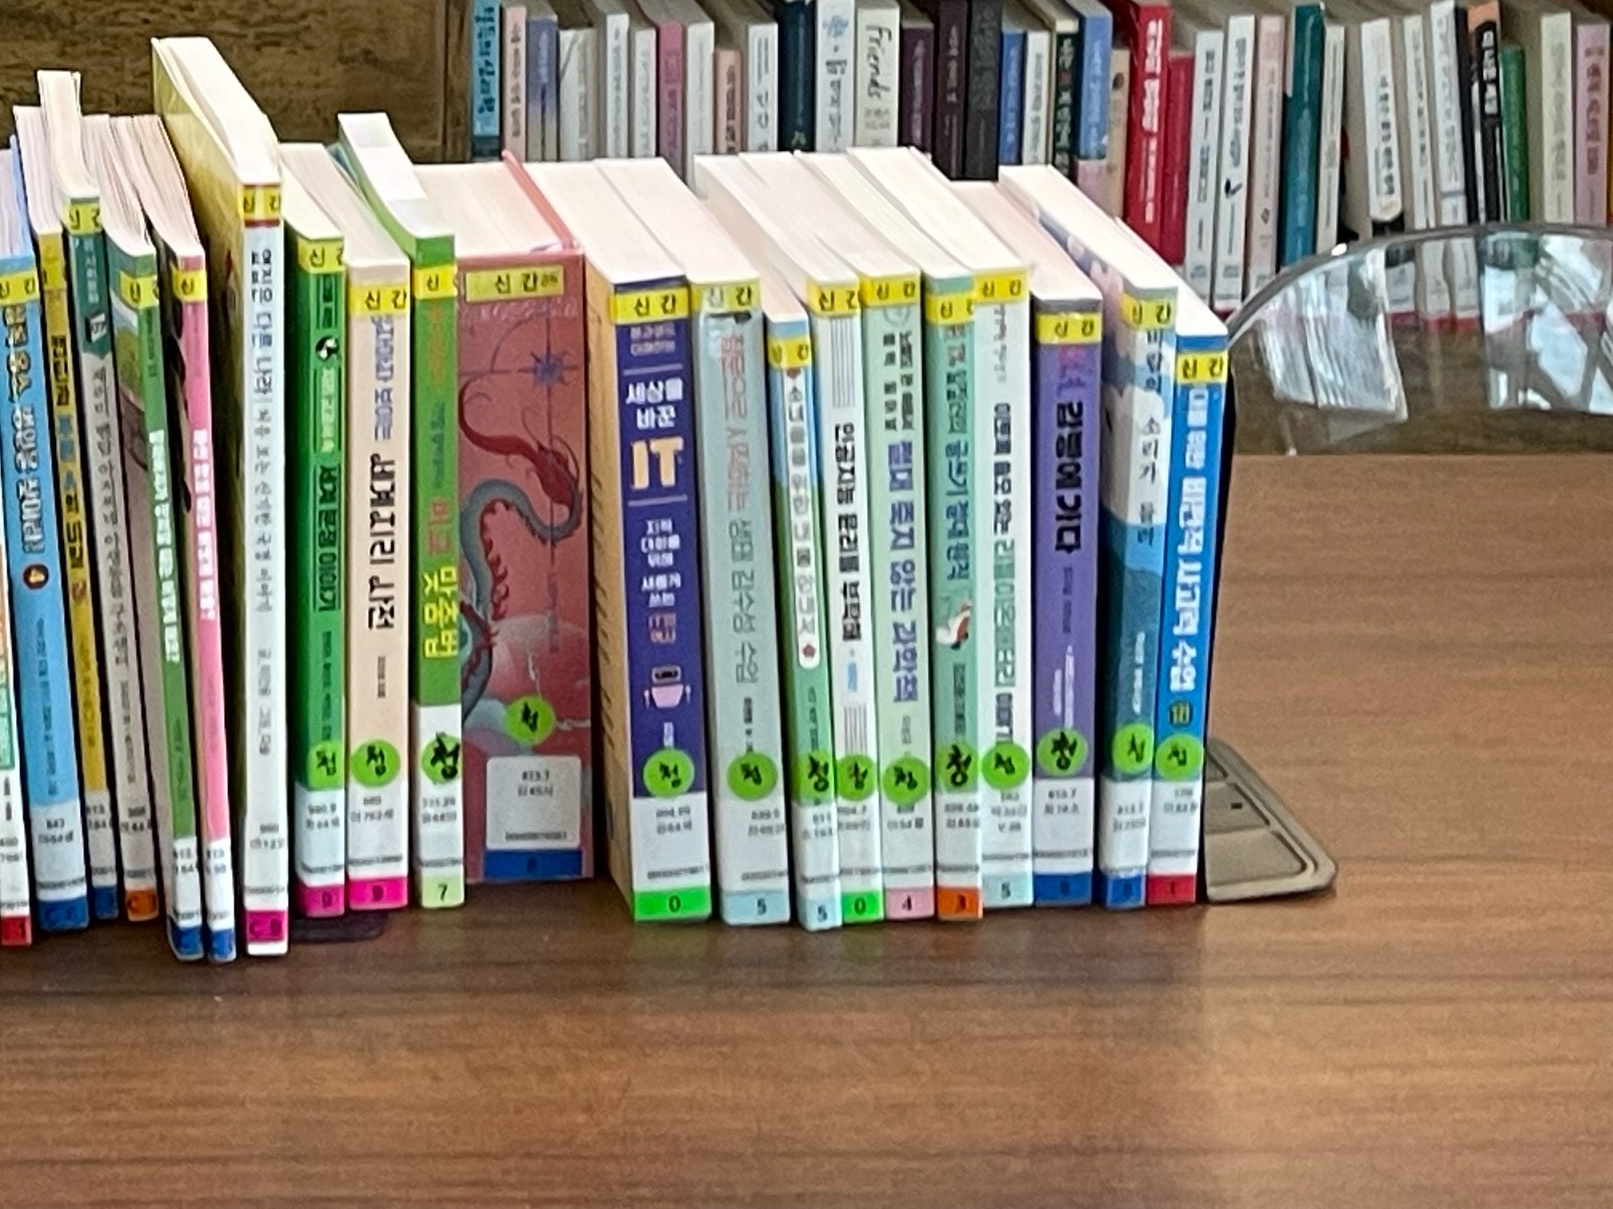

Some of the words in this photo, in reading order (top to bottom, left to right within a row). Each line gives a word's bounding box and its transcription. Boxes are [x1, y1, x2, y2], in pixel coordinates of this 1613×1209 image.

[866, 26, 892, 99] Friends
[252, 312, 272, 348] 다른
[253, 357, 273, 395] 나라
[632, 437, 684, 489] IT
[836, 423, 857, 504] 인공지능
[945, 440, 969, 495] 글쓰기
[369, 453, 395, 565] 세계지리
[890, 500, 915, 550] 죽지
[1177, 476, 1206, 553] 비판적
[729, 520, 753, 561] 생태
[368, 576, 395, 629] 사전
[424, 565, 459, 659] 맞춤법
[732, 570, 755, 634] 감수성
[891, 560, 916, 612] 않는
[1173, 559, 1202, 635] 사고력
[736, 642, 758, 683] 수업
[893, 621, 918, 702] 과학책
[1170, 641, 1197, 692] 수업
